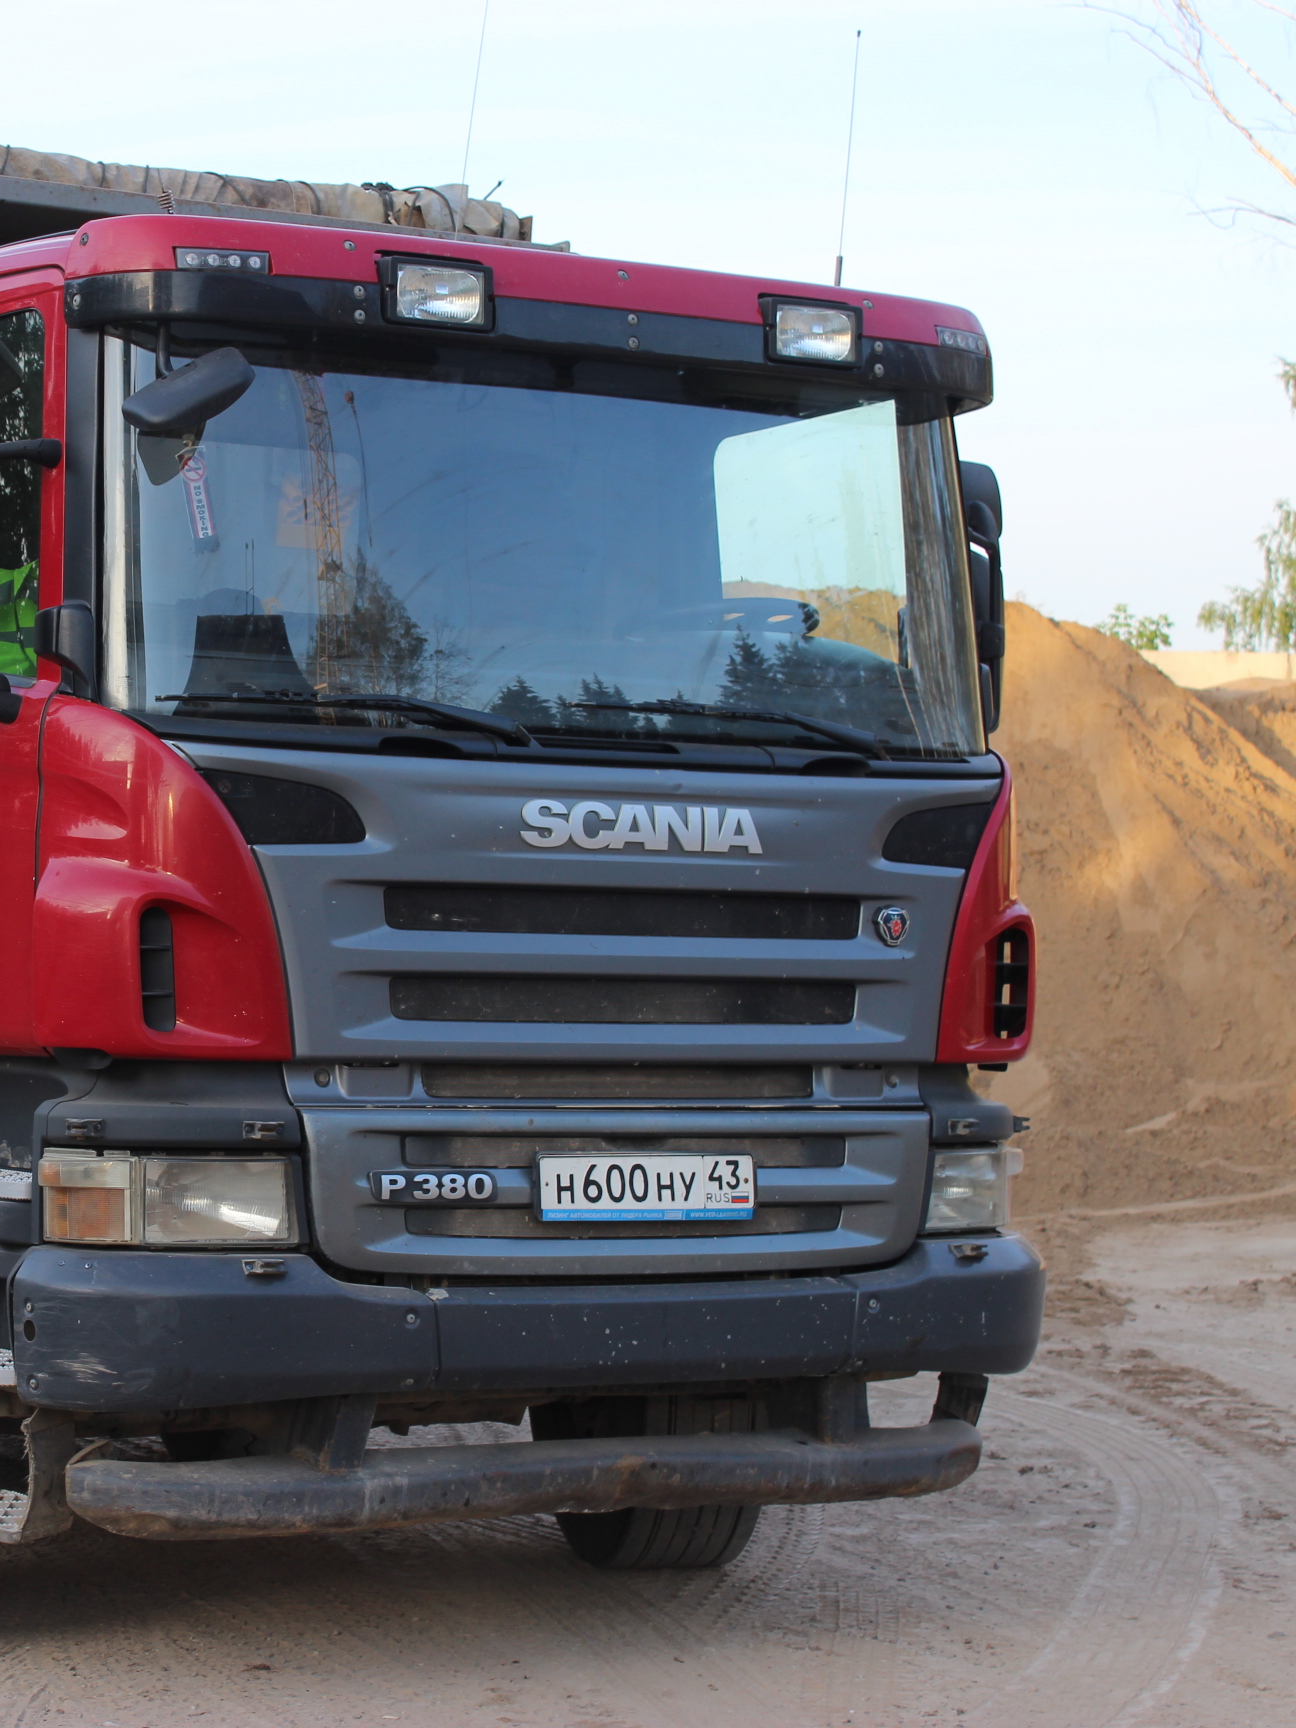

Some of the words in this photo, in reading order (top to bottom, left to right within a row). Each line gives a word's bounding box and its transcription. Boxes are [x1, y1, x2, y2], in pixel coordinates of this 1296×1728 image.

[193, 485, 202, 497] NO
[196, 498, 209, 538] SMOKING
[520, 798, 764, 855] SCANIA
[381, 1174, 407, 1200] P
[412, 1173, 493, 1200] 380
[708, 1160, 740, 1190] 43
[706, 1192, 730, 1203] RUS
